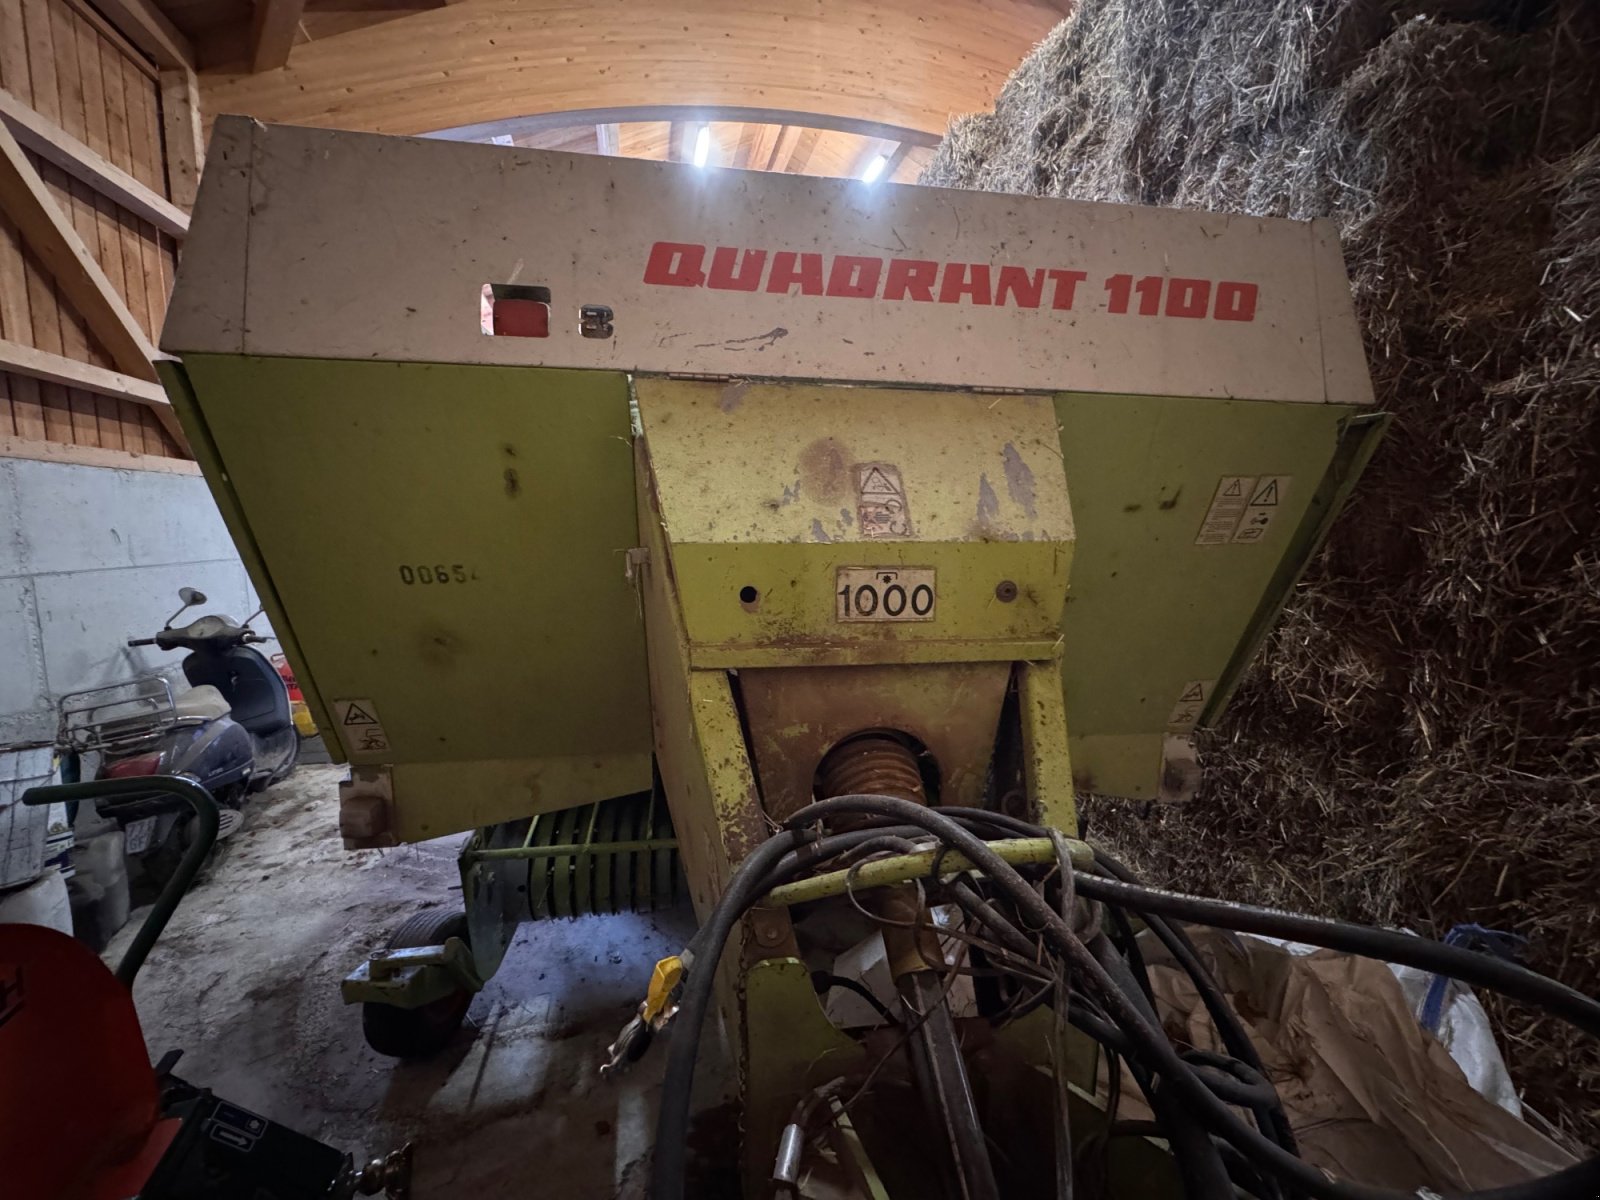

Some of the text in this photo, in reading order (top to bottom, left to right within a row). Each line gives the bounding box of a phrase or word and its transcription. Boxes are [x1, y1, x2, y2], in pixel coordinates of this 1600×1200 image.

[643, 241, 1259, 322] QUADRANT 1100
[837, 584, 934, 617] 1000
